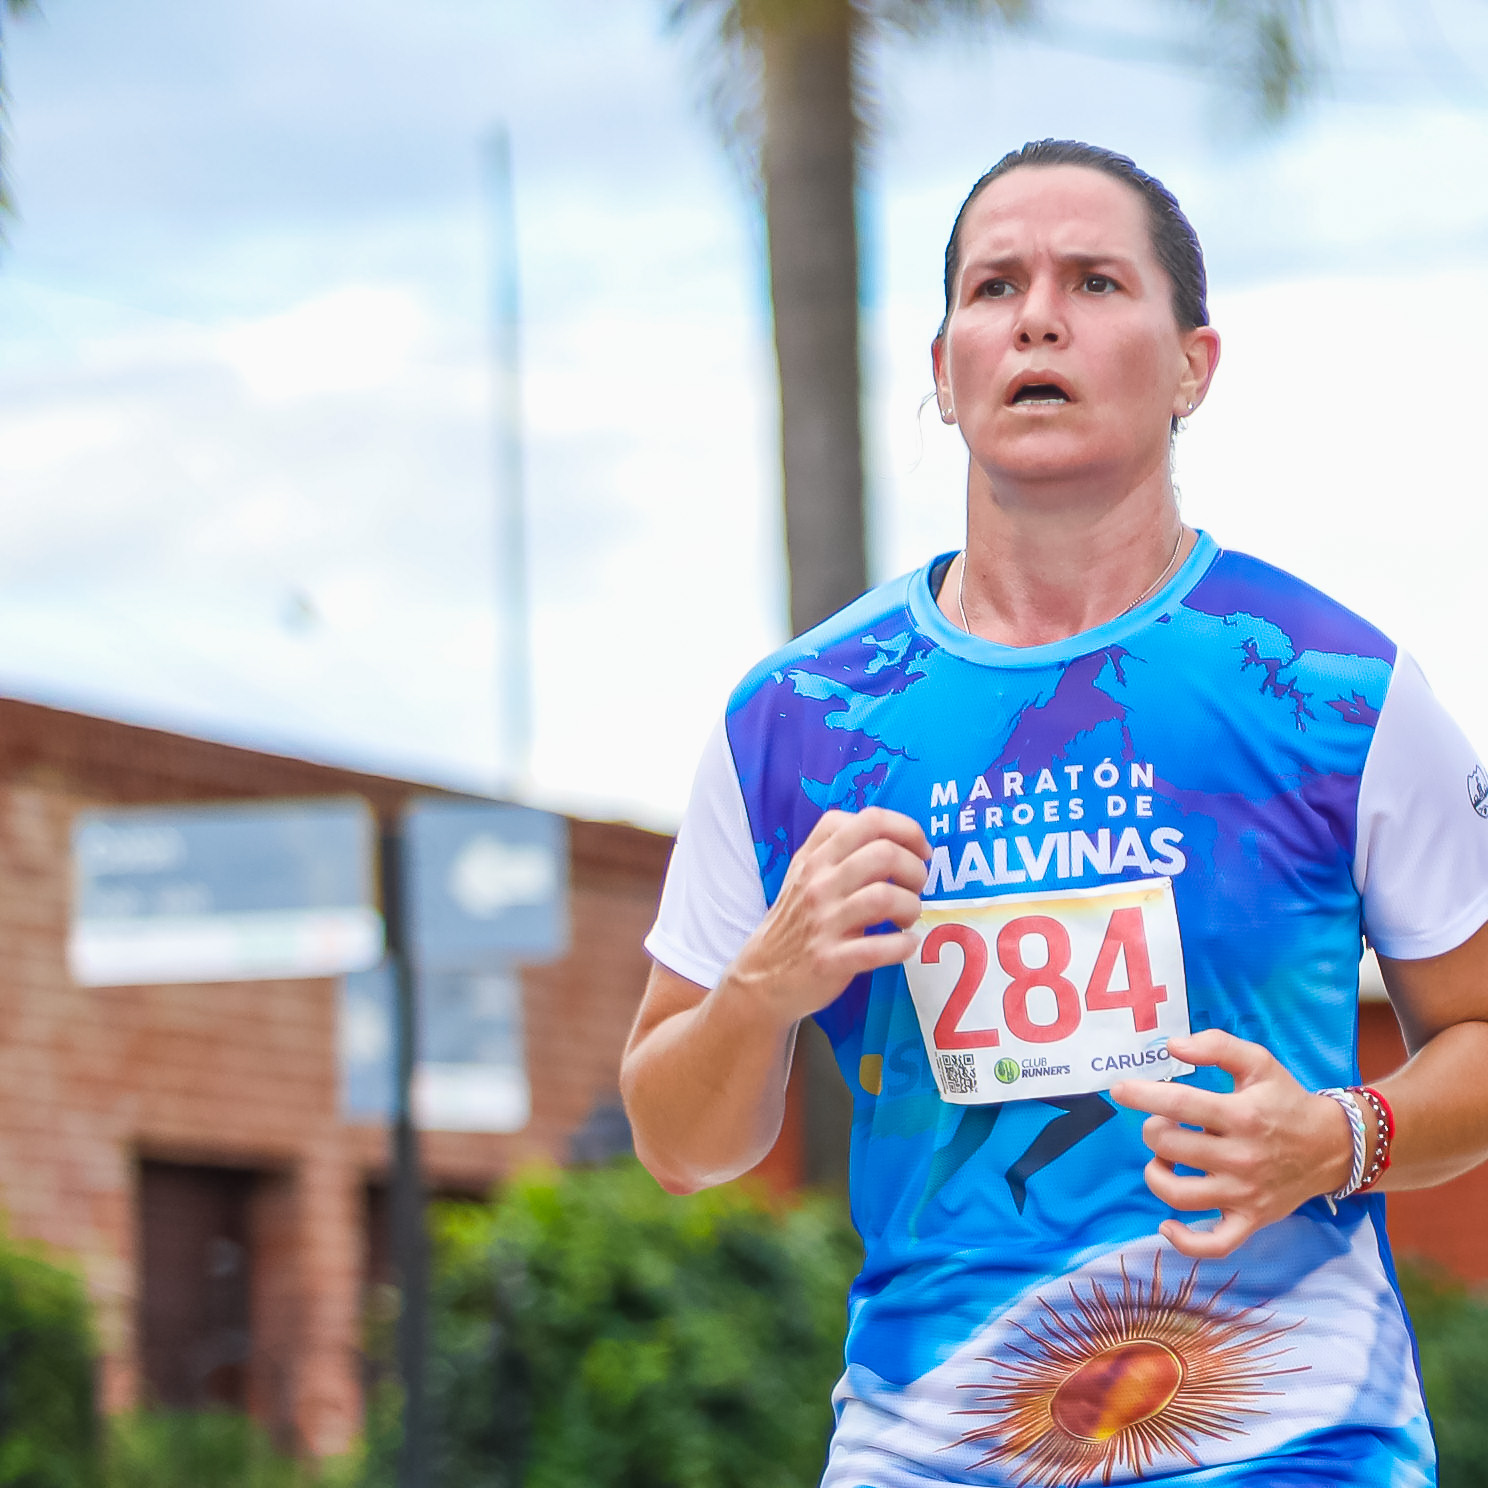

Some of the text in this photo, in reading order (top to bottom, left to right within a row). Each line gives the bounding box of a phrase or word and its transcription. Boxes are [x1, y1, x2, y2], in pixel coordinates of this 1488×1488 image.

[930, 757, 1154, 808] MARATÓN
[930, 795, 1153, 836] HÉROES DE
[923, 827, 1187, 896] MALVINAS
[920, 906, 1167, 1051] 284
[1021, 1057, 1048, 1069] CLUB
[1021, 1065, 1071, 1079] RUNNER'S
[1091, 1047, 1171, 1072] CARUSO
